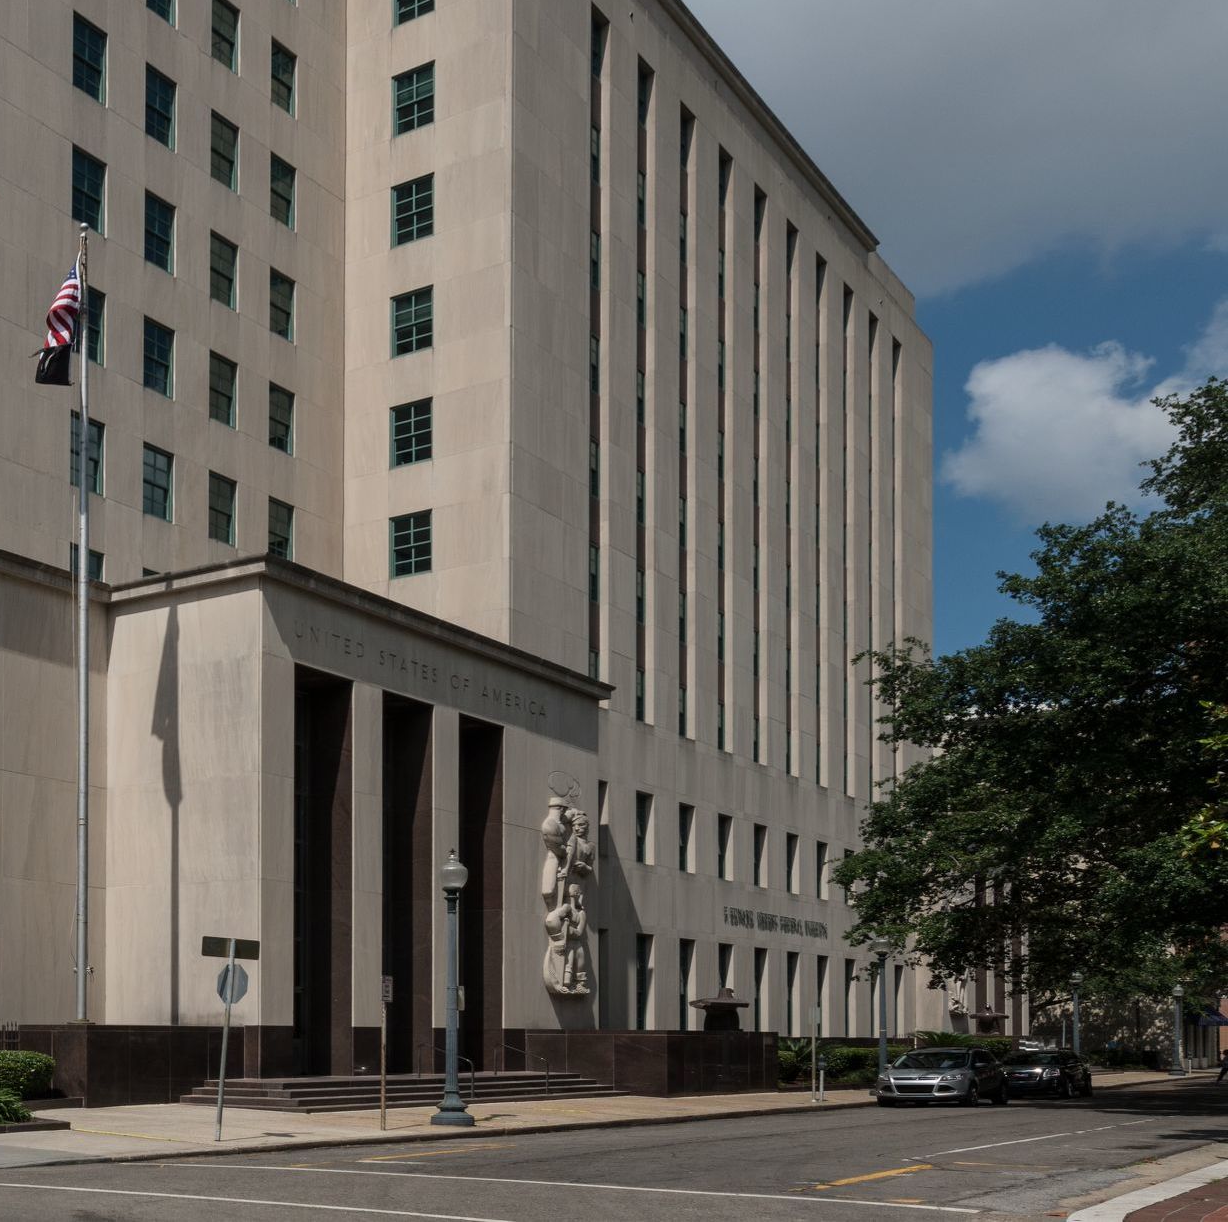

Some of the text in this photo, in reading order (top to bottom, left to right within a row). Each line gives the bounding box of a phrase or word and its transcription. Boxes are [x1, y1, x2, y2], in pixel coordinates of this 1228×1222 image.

[295, 620, 547, 717] UNITED STATES OF AMERICA
